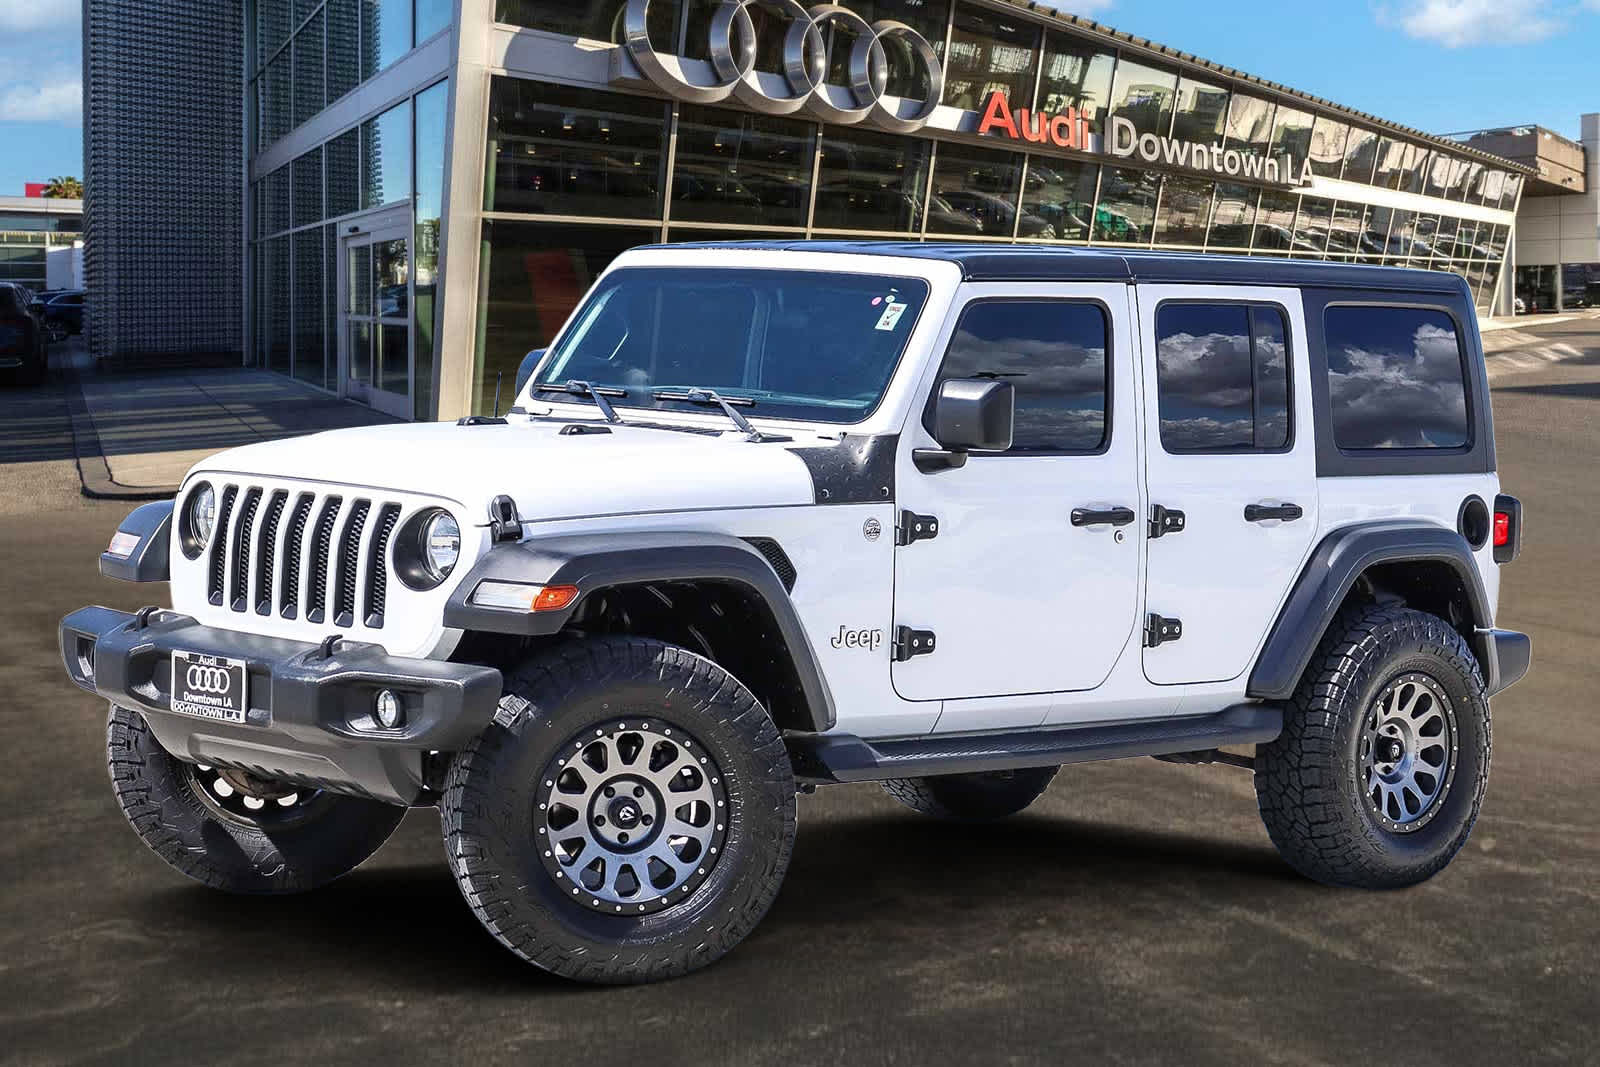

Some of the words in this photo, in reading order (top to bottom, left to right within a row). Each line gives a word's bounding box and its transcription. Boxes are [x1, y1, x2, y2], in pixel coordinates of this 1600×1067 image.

[978, 91, 1089, 150] Audi
[1107, 115, 1279, 182] Downtown
[1286, 153, 1315, 188] LA
[831, 624, 882, 651] Jeep
[198, 656, 217, 666] Audi
[183, 691, 222, 706] Downtown
[223, 697, 233, 708] LA
[175, 702, 223, 718] DOWNTOWN
